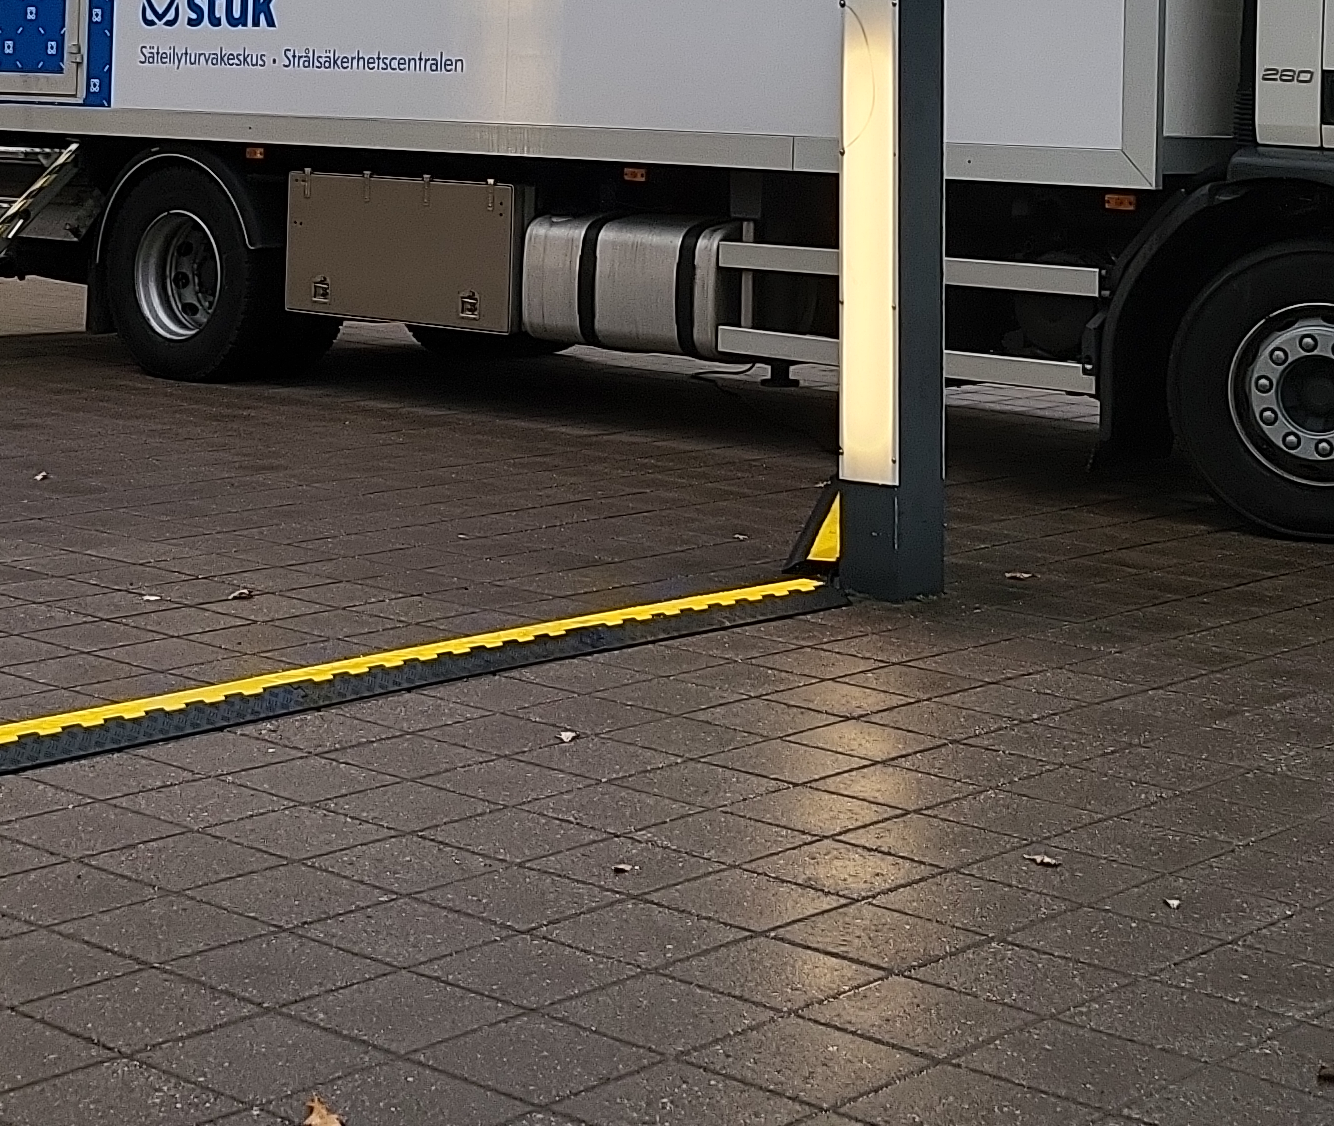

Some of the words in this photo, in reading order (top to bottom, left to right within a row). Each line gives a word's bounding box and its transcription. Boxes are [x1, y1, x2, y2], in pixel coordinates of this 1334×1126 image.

[138, 46, 266, 71] Säteilyturvakeskus
[282, 48, 465, 73] Strålsäkerhetscentralen
[1261, 67, 1315, 84] 280
